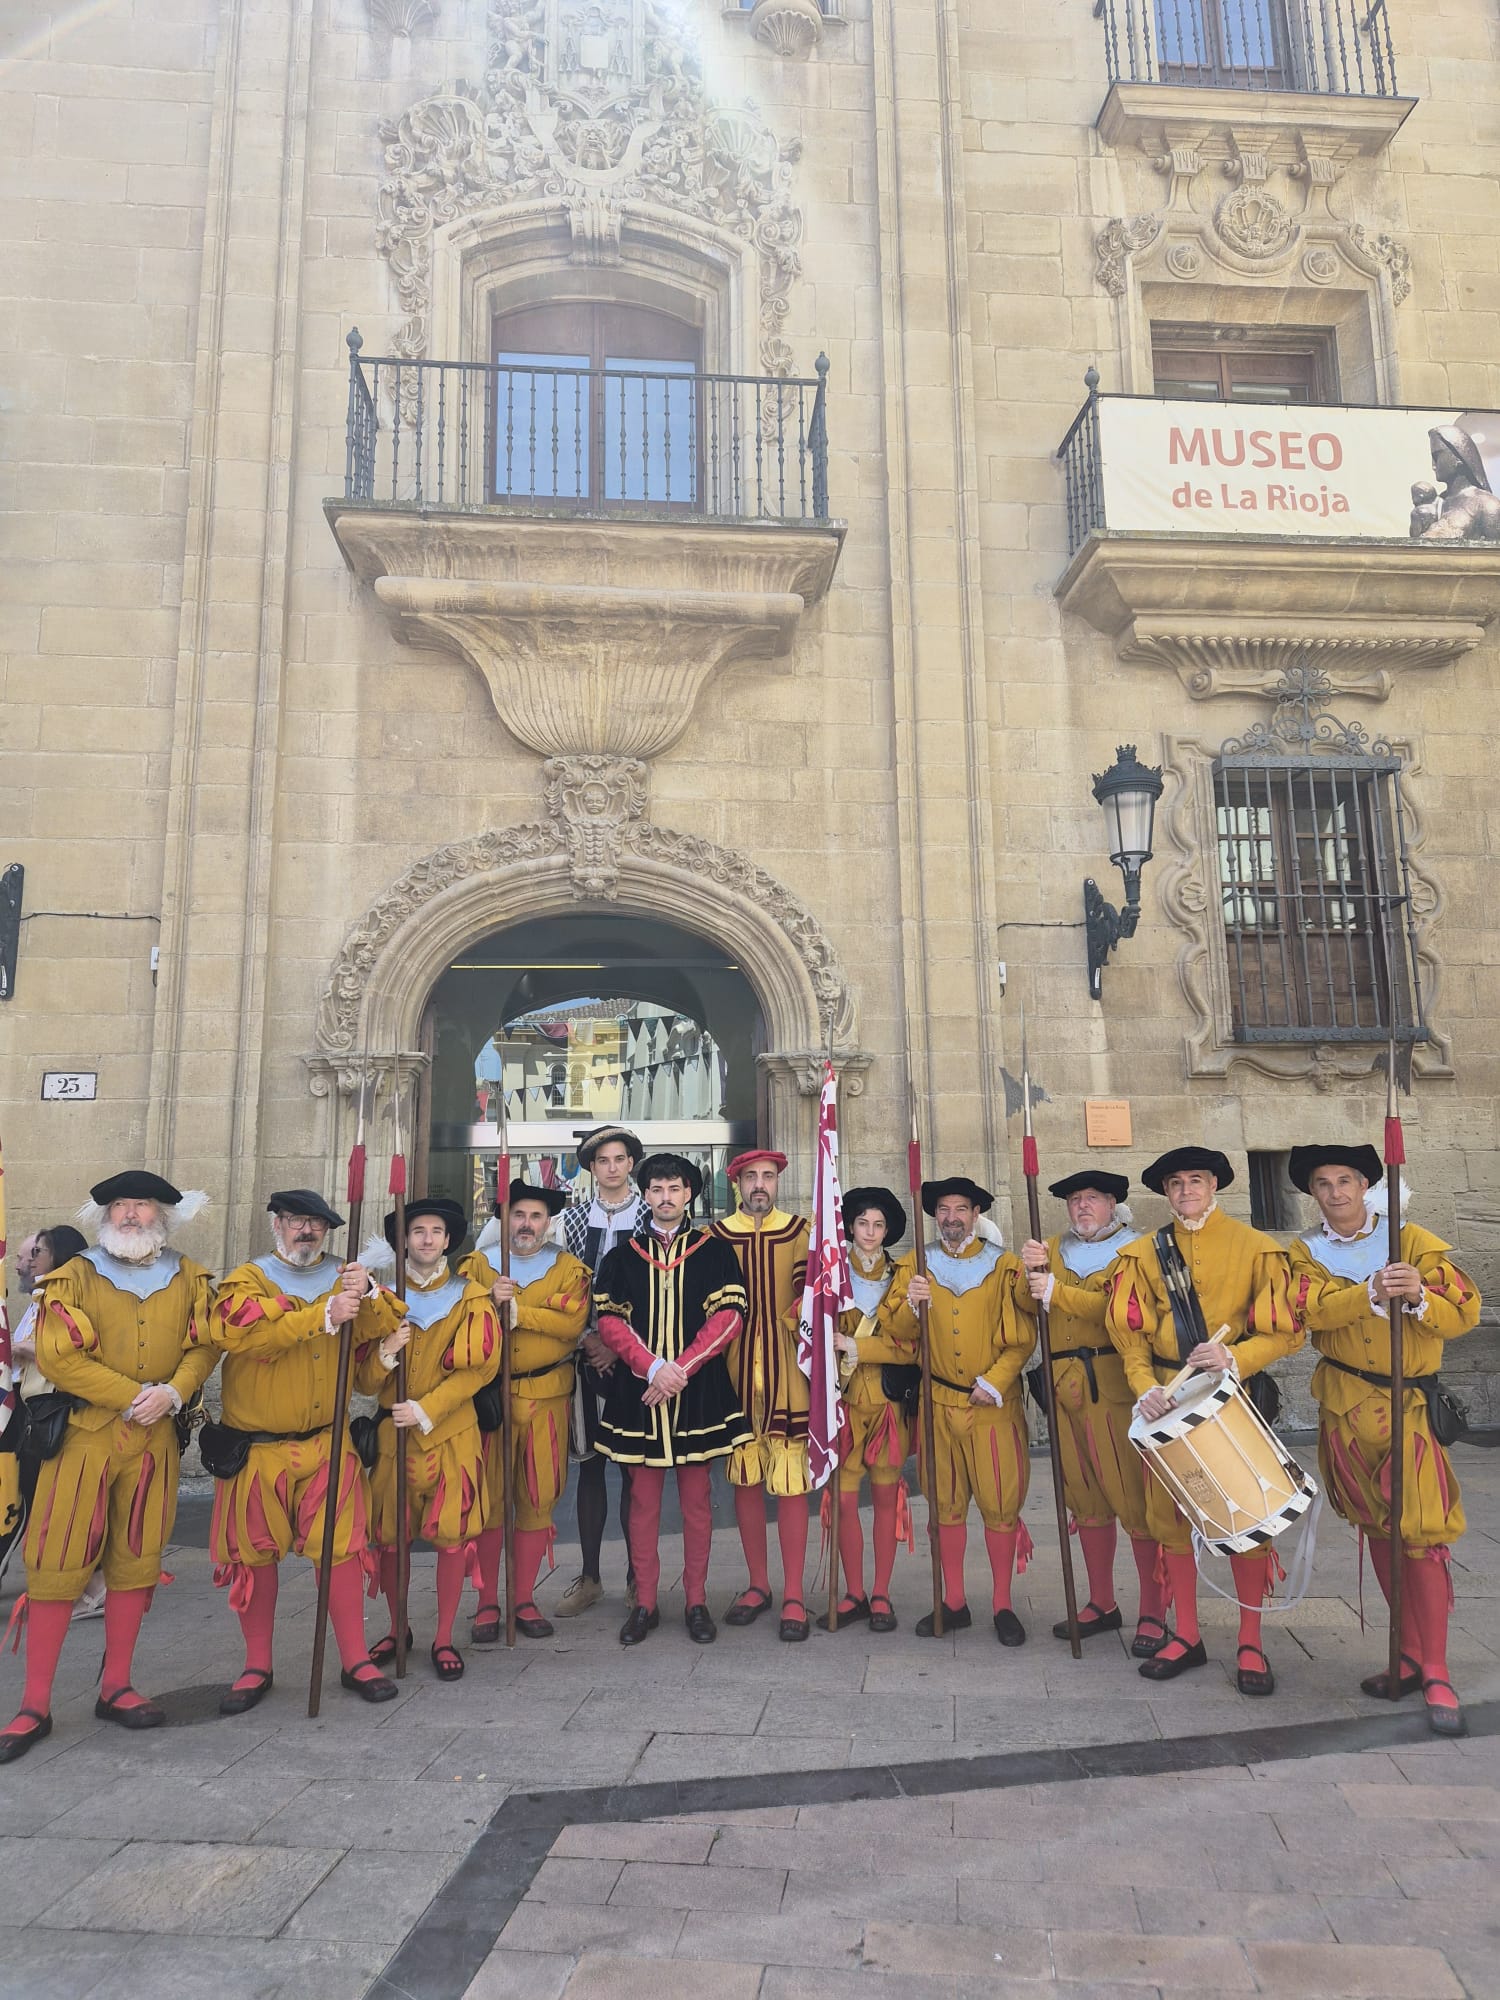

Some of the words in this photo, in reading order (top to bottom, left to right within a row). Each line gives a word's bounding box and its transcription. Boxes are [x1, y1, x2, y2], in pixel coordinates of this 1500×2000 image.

[1169, 427, 1343, 471] MUSEO
[1172, 481, 1212, 508] de
[1221, 483, 1258, 510] La
[1267, 484, 1350, 517] Rioja
[57, 1077, 80, 1093] 23
